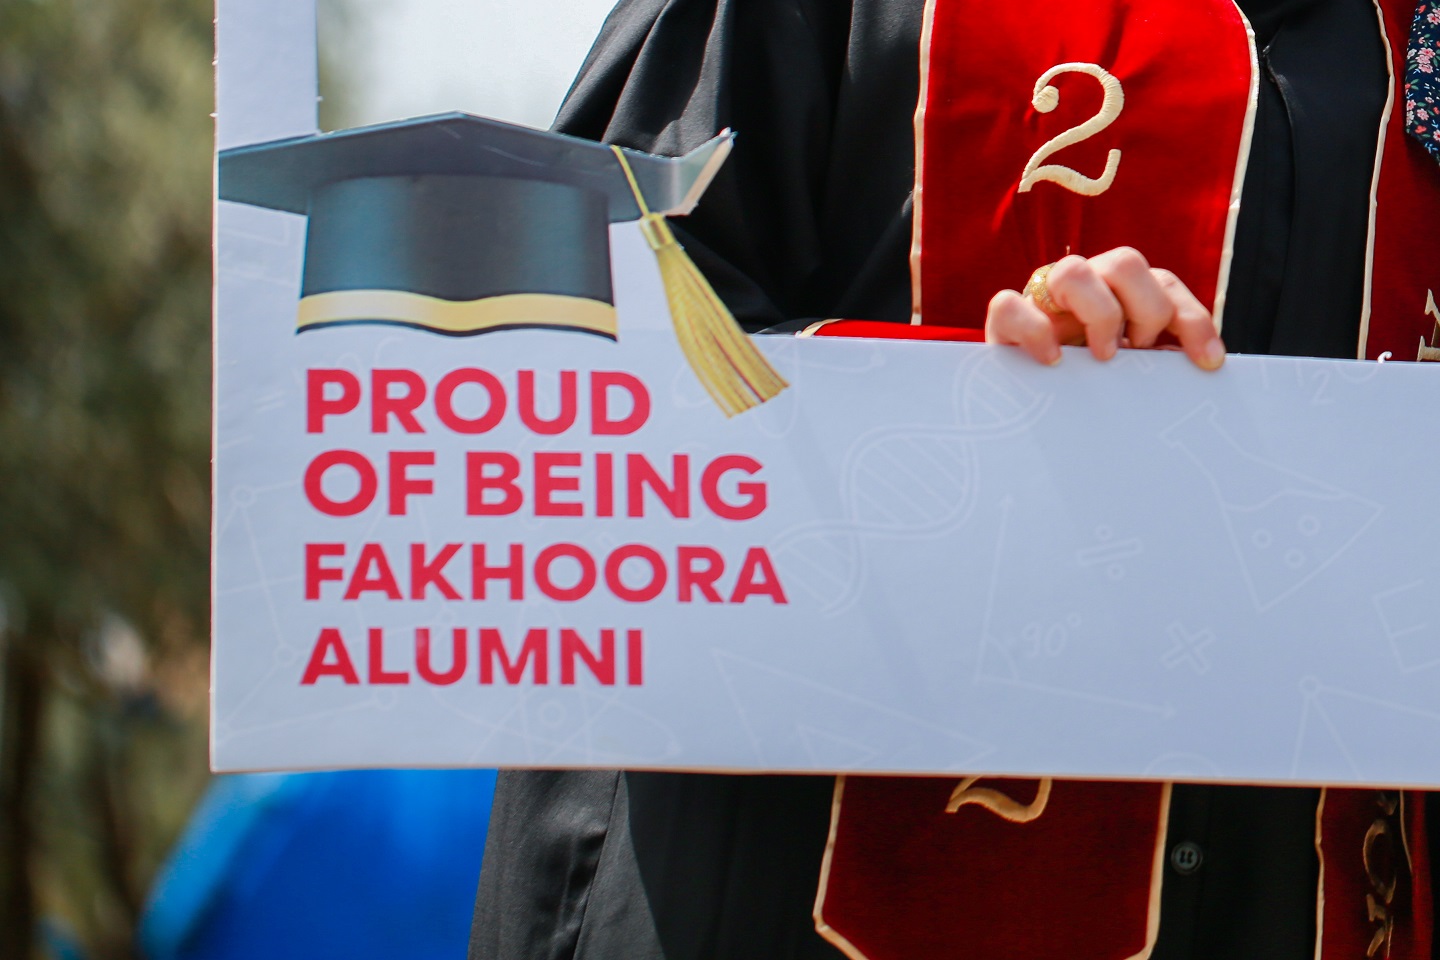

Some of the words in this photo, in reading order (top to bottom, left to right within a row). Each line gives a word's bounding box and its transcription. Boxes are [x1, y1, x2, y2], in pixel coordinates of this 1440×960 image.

[1018, 61, 1125, 197] 2
[306, 367, 651, 436] PROUD
[303, 448, 436, 518] OF
[465, 451, 768, 521] BEING
[304, 542, 788, 605] FAKHOORA
[300, 627, 644, 687] ALUMNI
